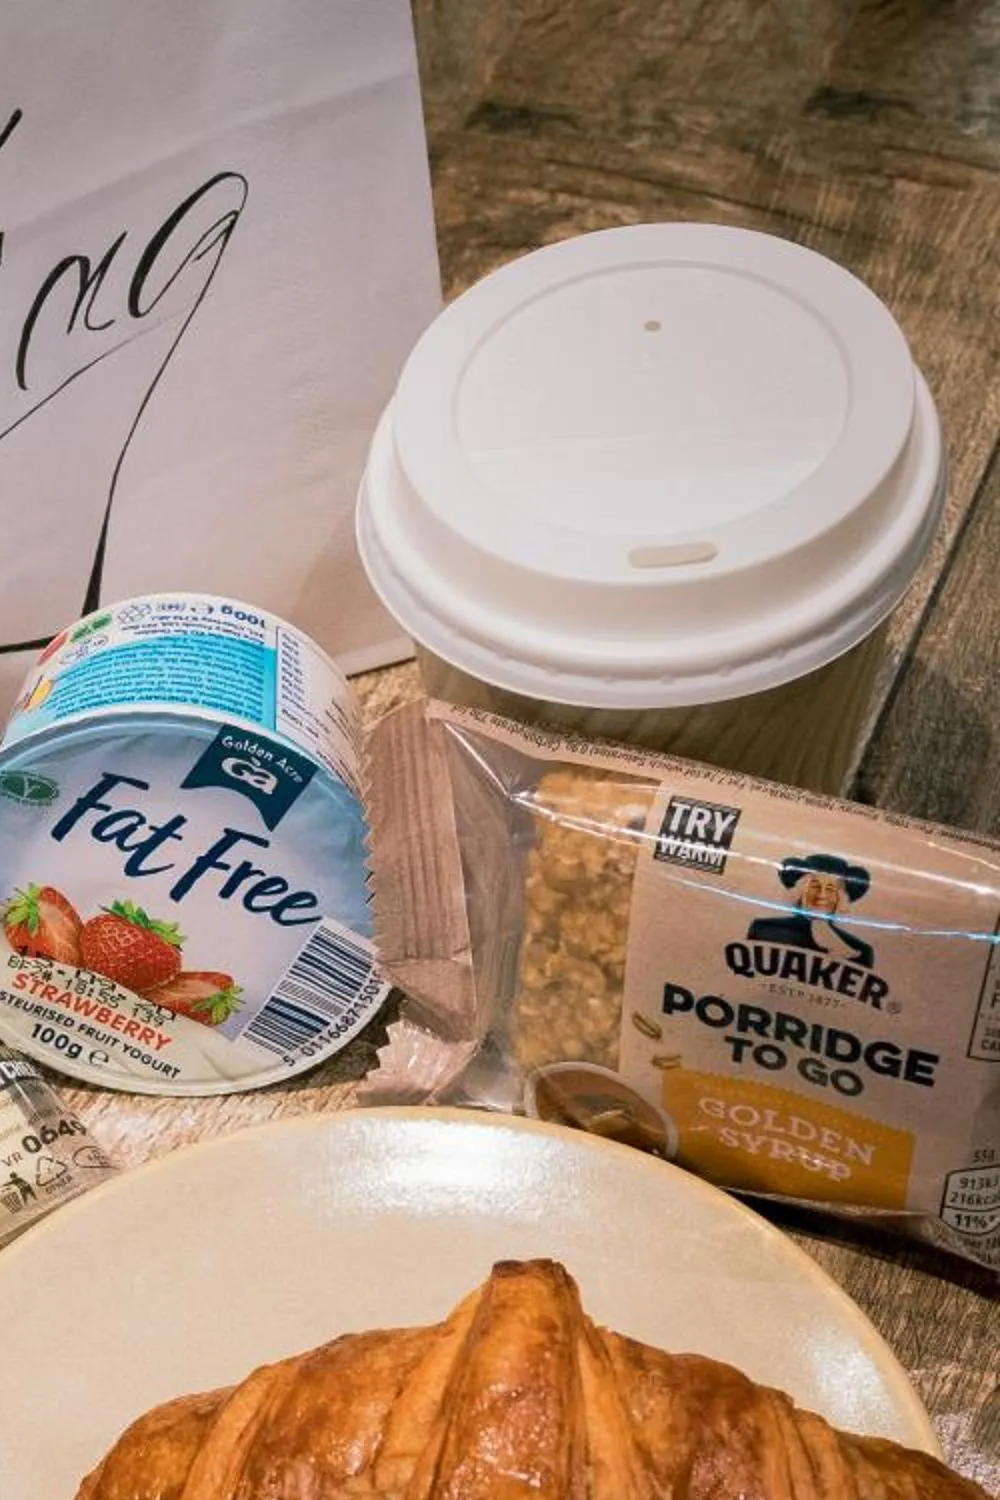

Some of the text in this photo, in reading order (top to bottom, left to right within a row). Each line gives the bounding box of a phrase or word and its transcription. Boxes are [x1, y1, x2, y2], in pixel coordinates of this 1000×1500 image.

[221, 734, 274, 762] Golden
[51, 771, 323, 927] Fat Free
[659, 834, 727, 867] WARM
[670, 802, 735, 842] TRY
[725, 941, 890, 1009] QUAKER
[10, 967, 172, 1057] STRAWBERRY
[28, 1020, 85, 1060] 100g
[662, 983, 940, 1089] PORRIDGE
[76, 1022, 118, 1049] FRUIT
[119, 1043, 181, 1081] YOGURT
[725, 1036, 865, 1097] TO GO
[699, 1097, 877, 1167] GOLDEN
[718, 1128, 853, 1182] SYRUP
